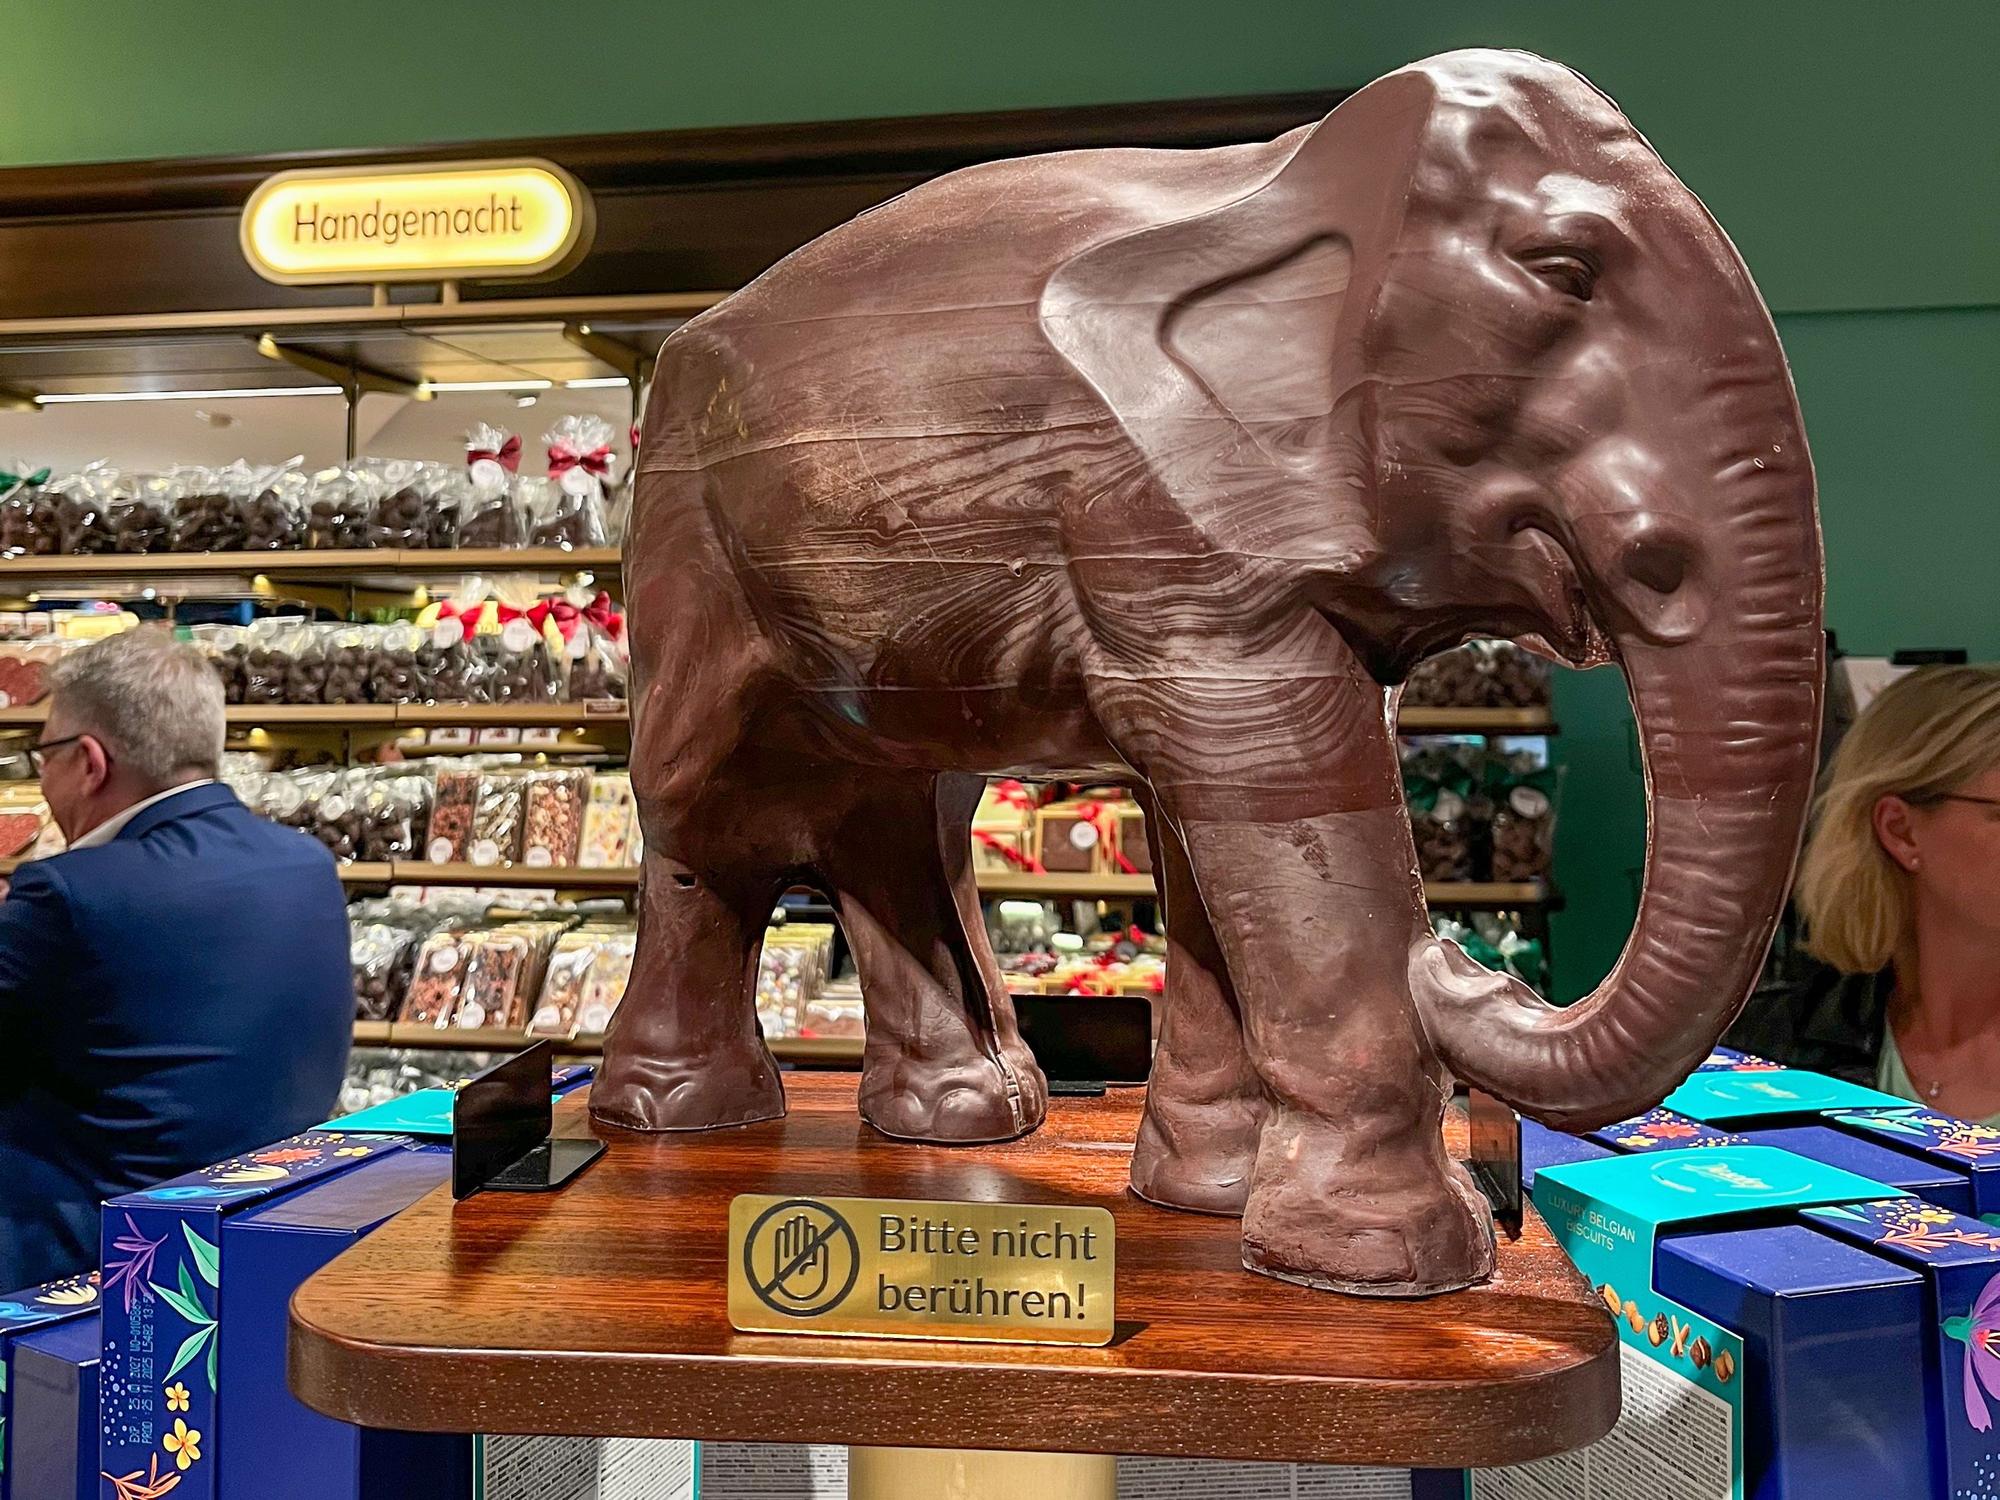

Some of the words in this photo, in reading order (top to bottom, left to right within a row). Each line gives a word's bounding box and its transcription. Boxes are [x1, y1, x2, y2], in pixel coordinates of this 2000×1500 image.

[293, 193, 523, 245] Handgemacht
[879, 1213, 979, 1256] Bitte
[991, 1220, 1098, 1261] nicht
[1547, 1192, 1587, 1220] LUXURY
[1589, 1210, 1636, 1244] BELGIAN
[1566, 1218, 1614, 1251] BISCUITS
[877, 1273, 1086, 1321] berühren!
